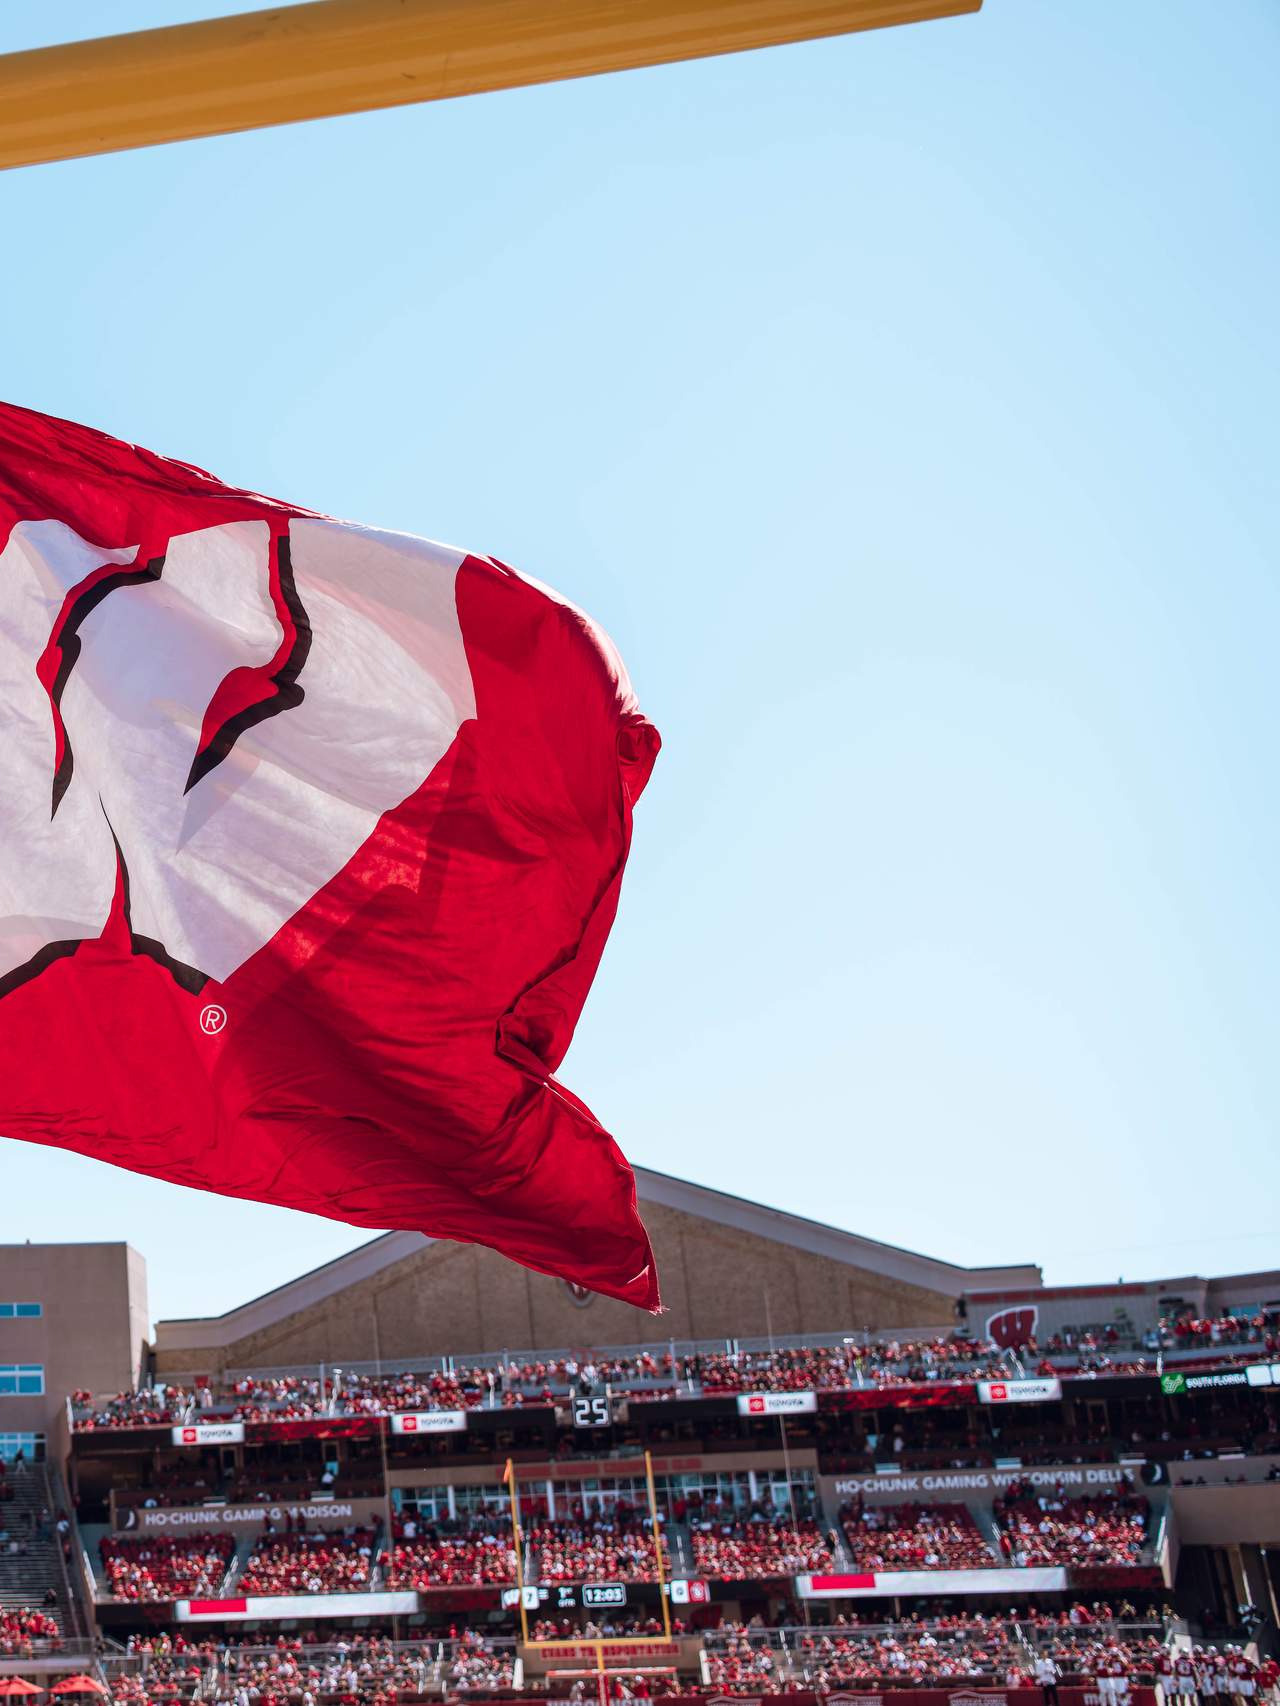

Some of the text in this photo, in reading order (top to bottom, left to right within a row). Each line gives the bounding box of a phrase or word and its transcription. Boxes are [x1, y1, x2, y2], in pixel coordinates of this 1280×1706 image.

[575, 1398, 609, 1425] 25
[835, 1478, 919, 1495] HO-CHUNK
[921, 1474, 989, 1490] GAMING
[145, 1510, 220, 1526] HO-CHUNK
[585, 1587, 623, 1603] 12:03
